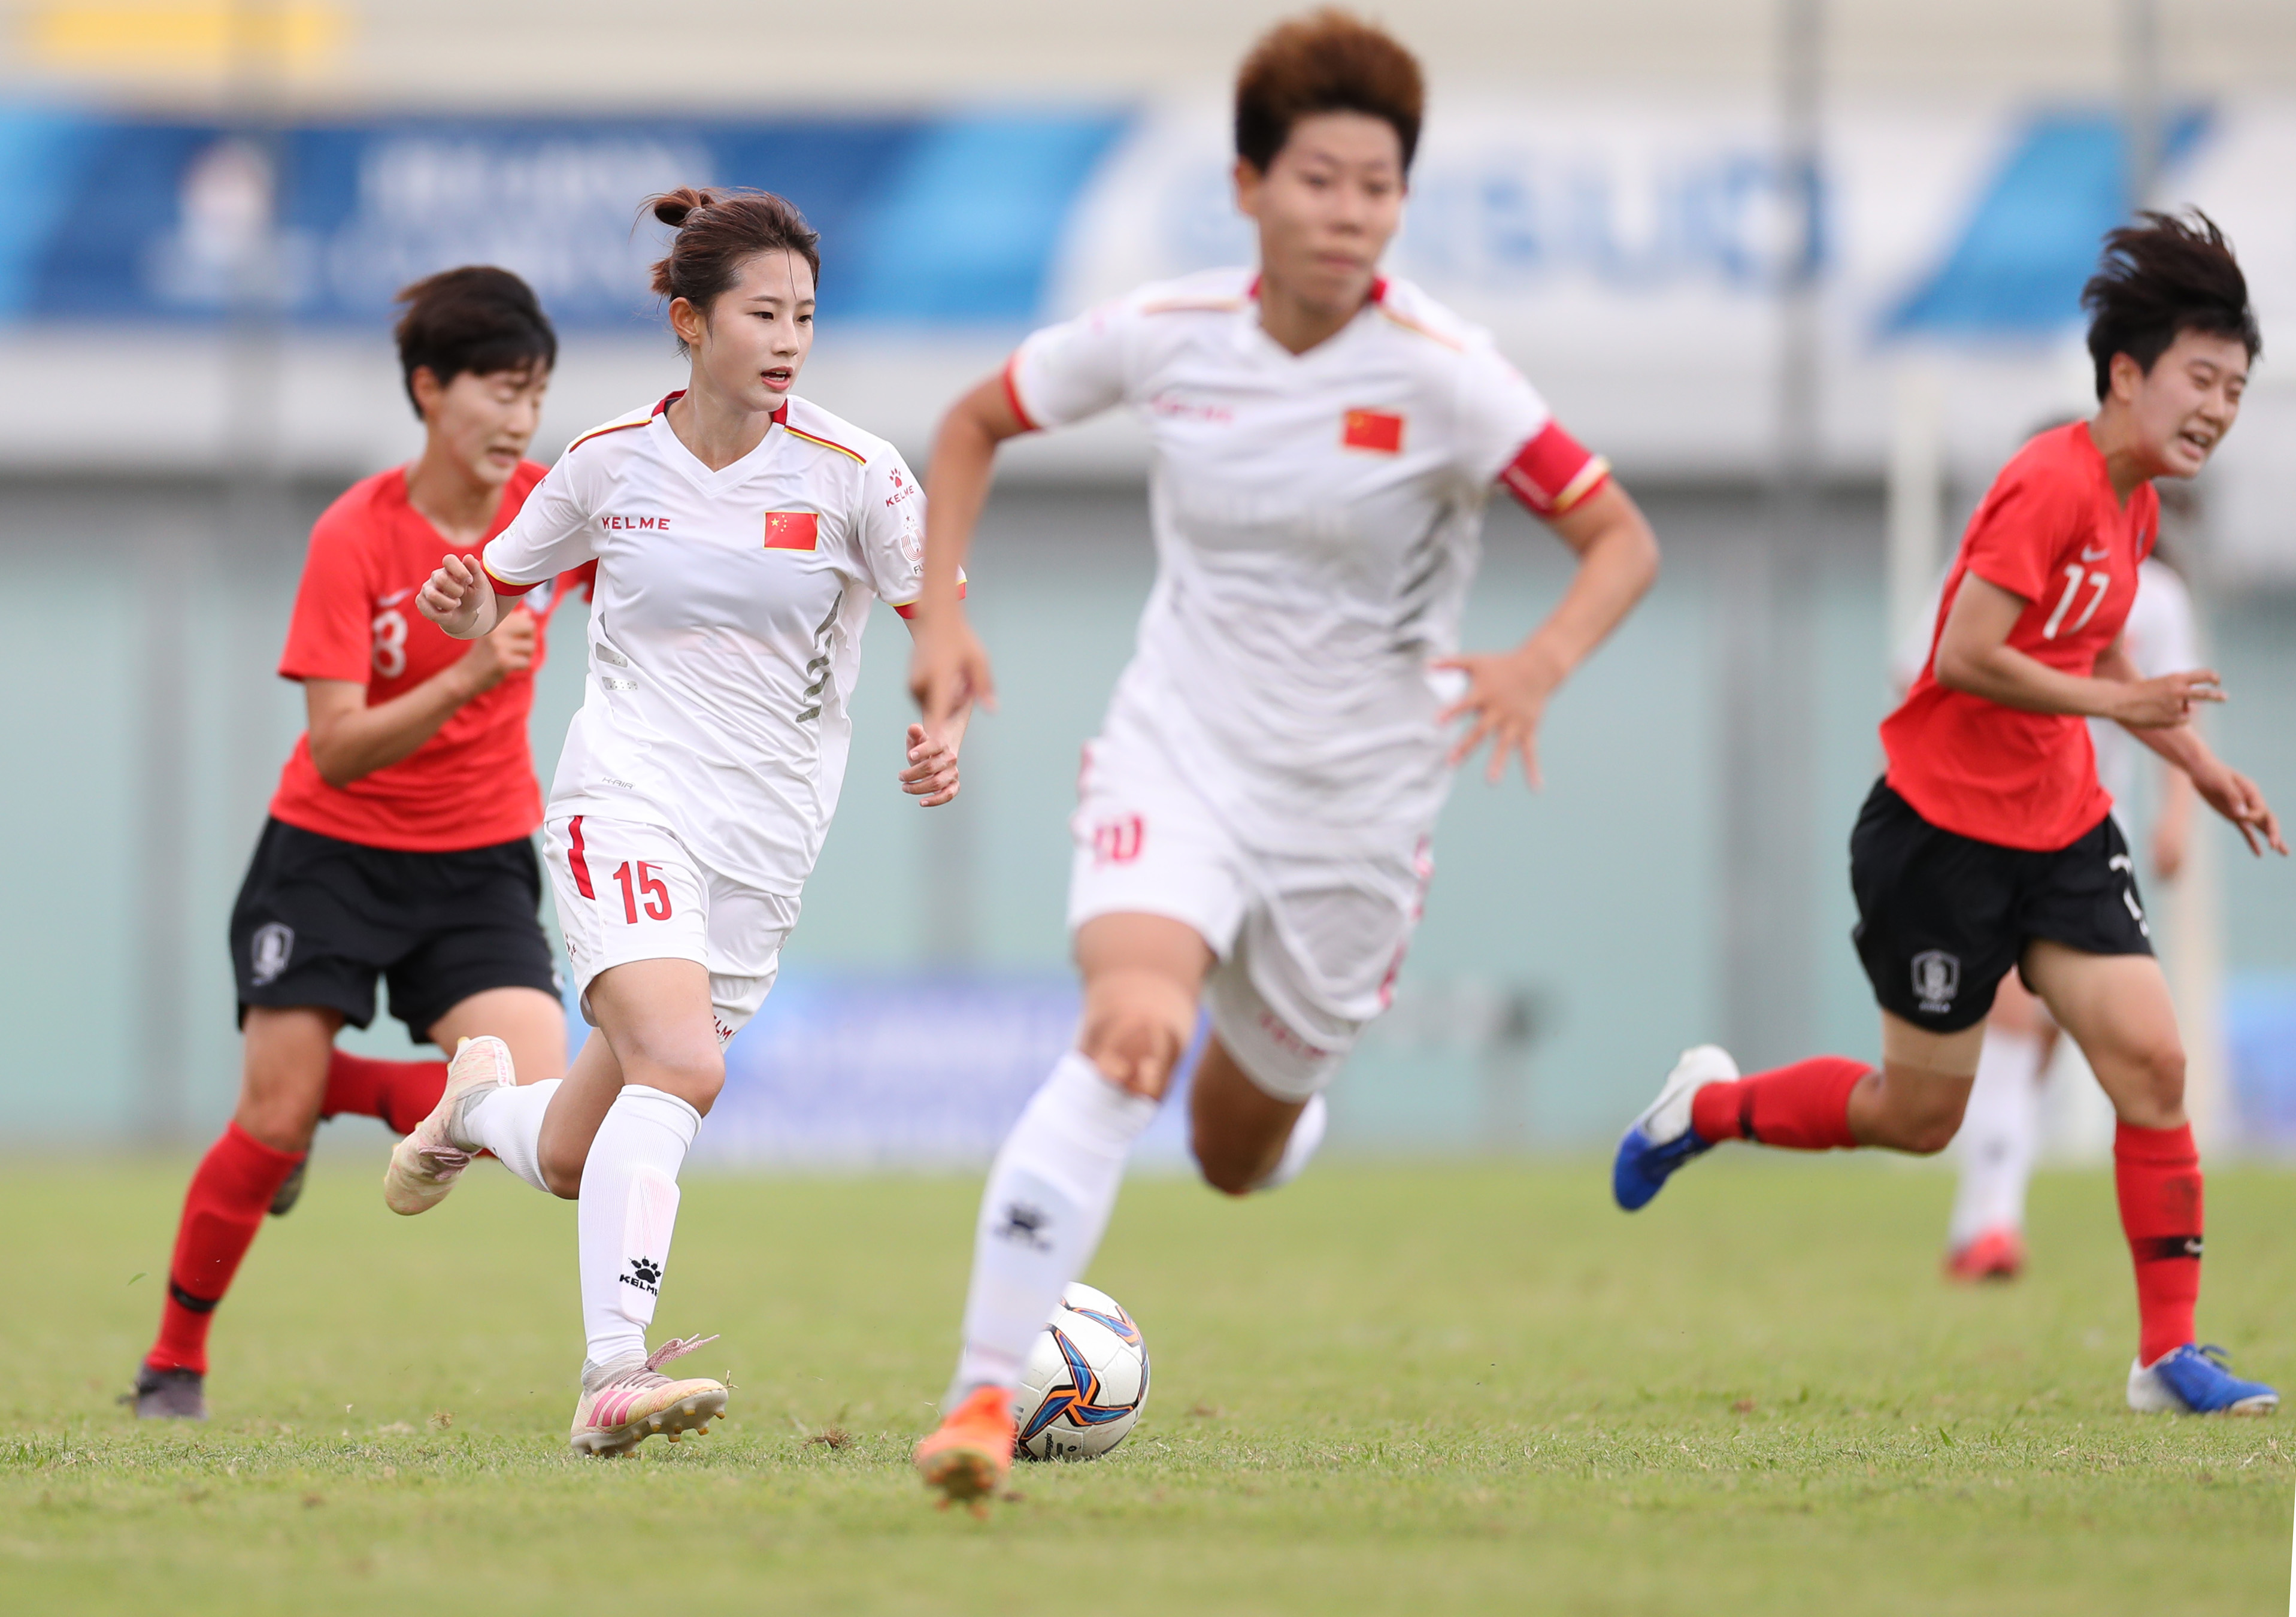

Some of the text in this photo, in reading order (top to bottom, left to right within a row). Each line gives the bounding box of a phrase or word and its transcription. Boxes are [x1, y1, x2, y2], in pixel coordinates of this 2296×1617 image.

[886, 485, 914, 507] KELME
[601, 517, 671, 530] KELME
[2042, 562, 2110, 640] 17
[372, 609, 408, 679] 8
[602, 777, 634, 789] K-AIR
[613, 860, 672, 924] 15
